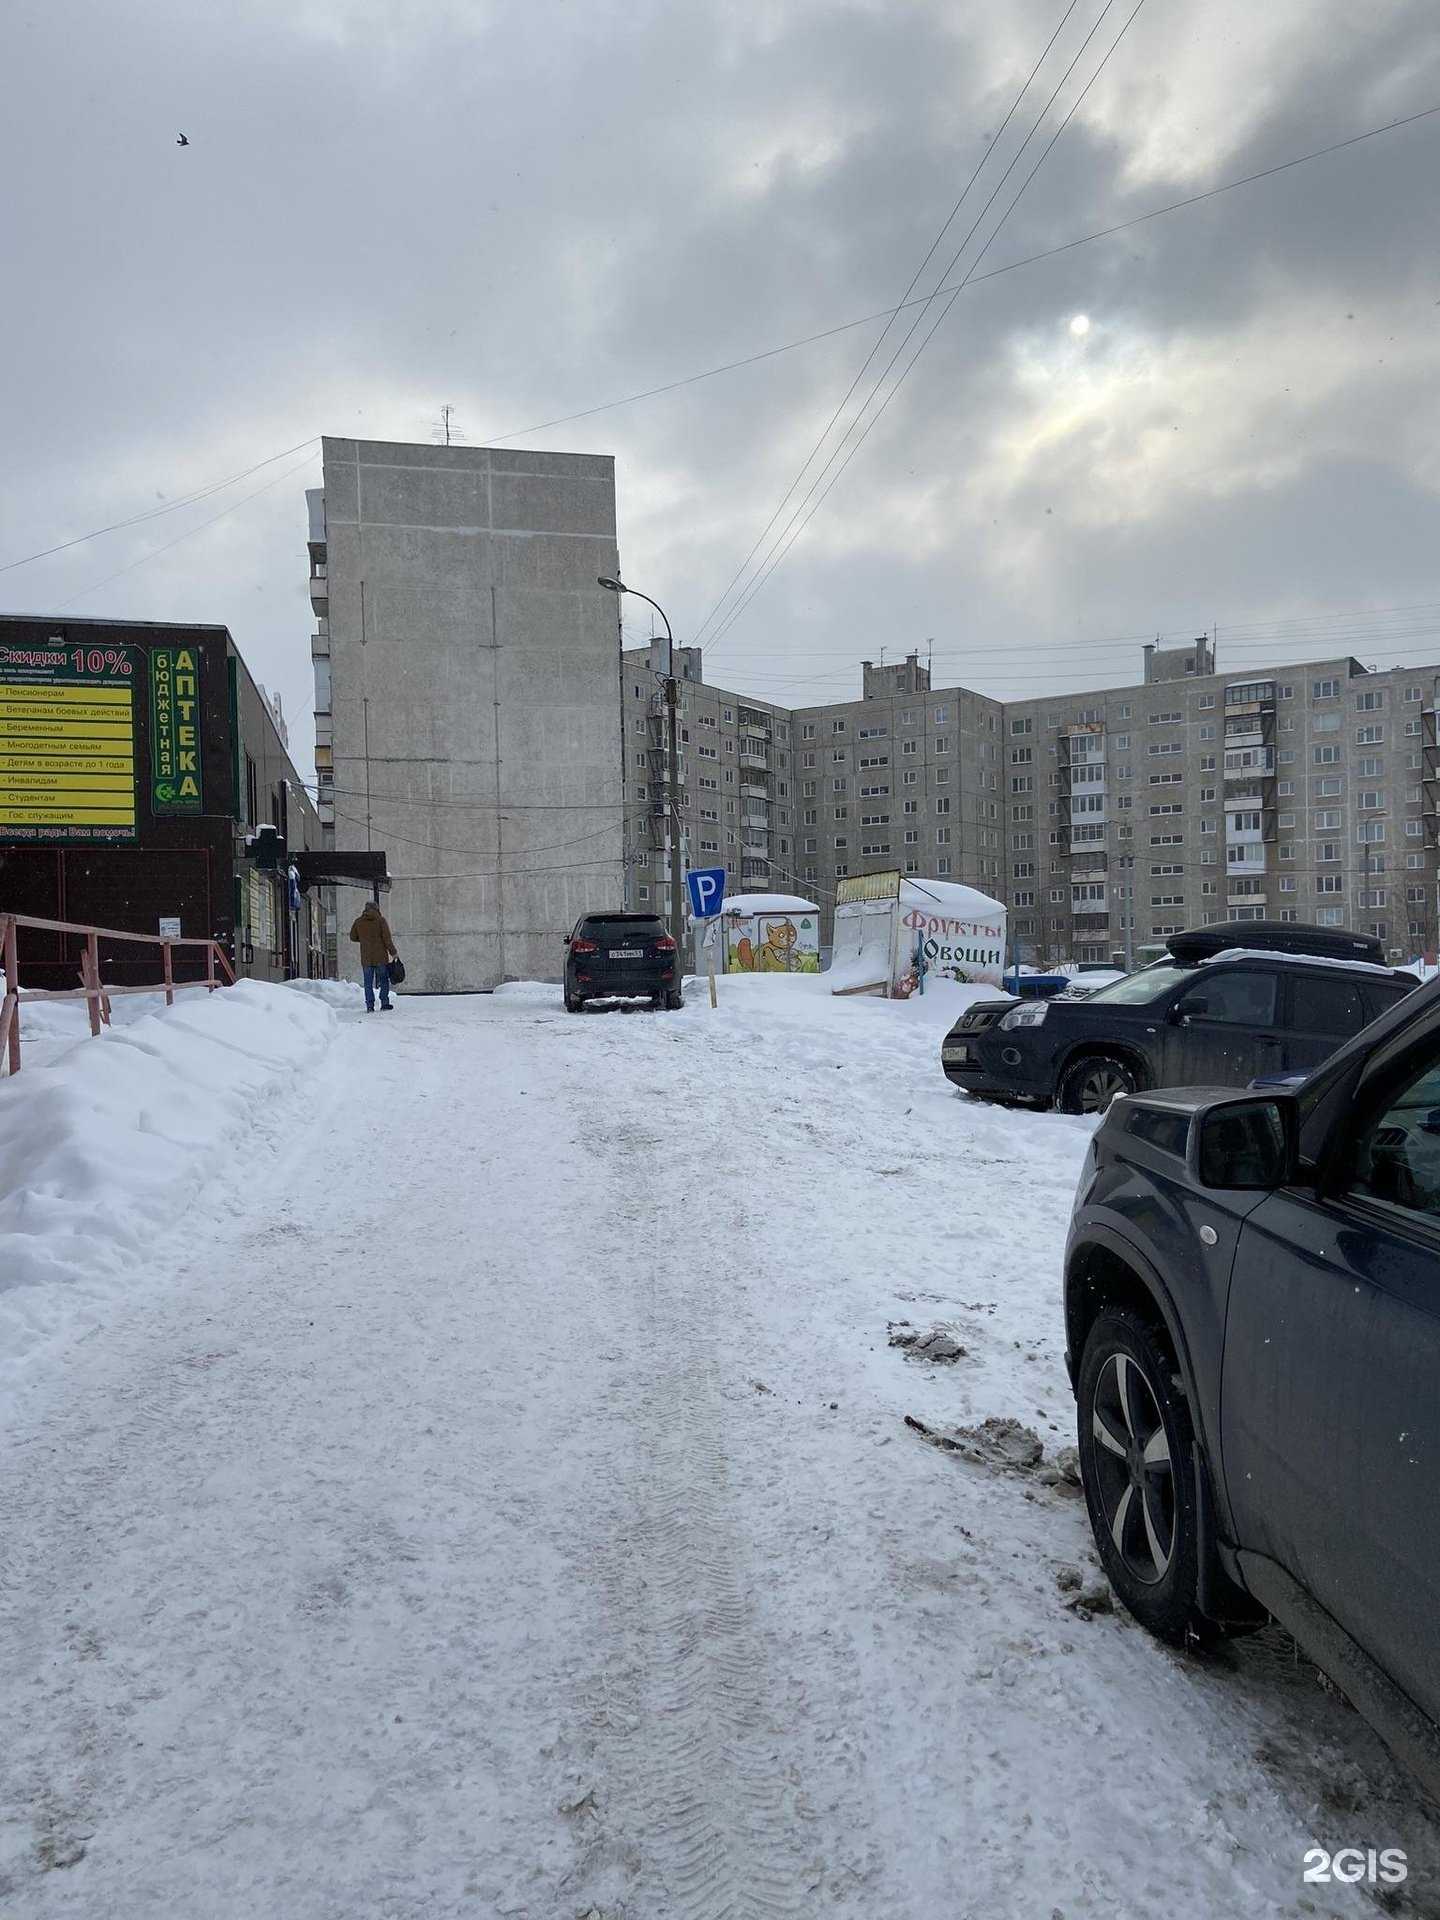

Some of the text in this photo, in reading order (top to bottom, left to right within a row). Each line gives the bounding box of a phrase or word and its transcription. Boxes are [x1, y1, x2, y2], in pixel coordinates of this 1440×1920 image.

[0, 647, 133, 675] Скидки 10%
[5, 687, 65, 697] Пенсионерам
[6, 705, 130, 717] Ветеранам боевых действий
[155, 654, 171, 775] бюджетная
[6, 723, 64, 732] Беременным
[175, 650, 199, 796] АПТЕКА
[7, 741, 102, 751] Многодетным семьям
[7, 759, 35, 768] Детям
[45, 761, 83, 769] возрасте
[85, 761, 97, 769] до
[7, 776, 58, 785] Инвалидам
[8, 793, 56, 802] Студентам
[696, 875, 716, 912] P
[903, 908, 1001, 940] Фрукты
[923, 938, 1000, 968] Овощи
